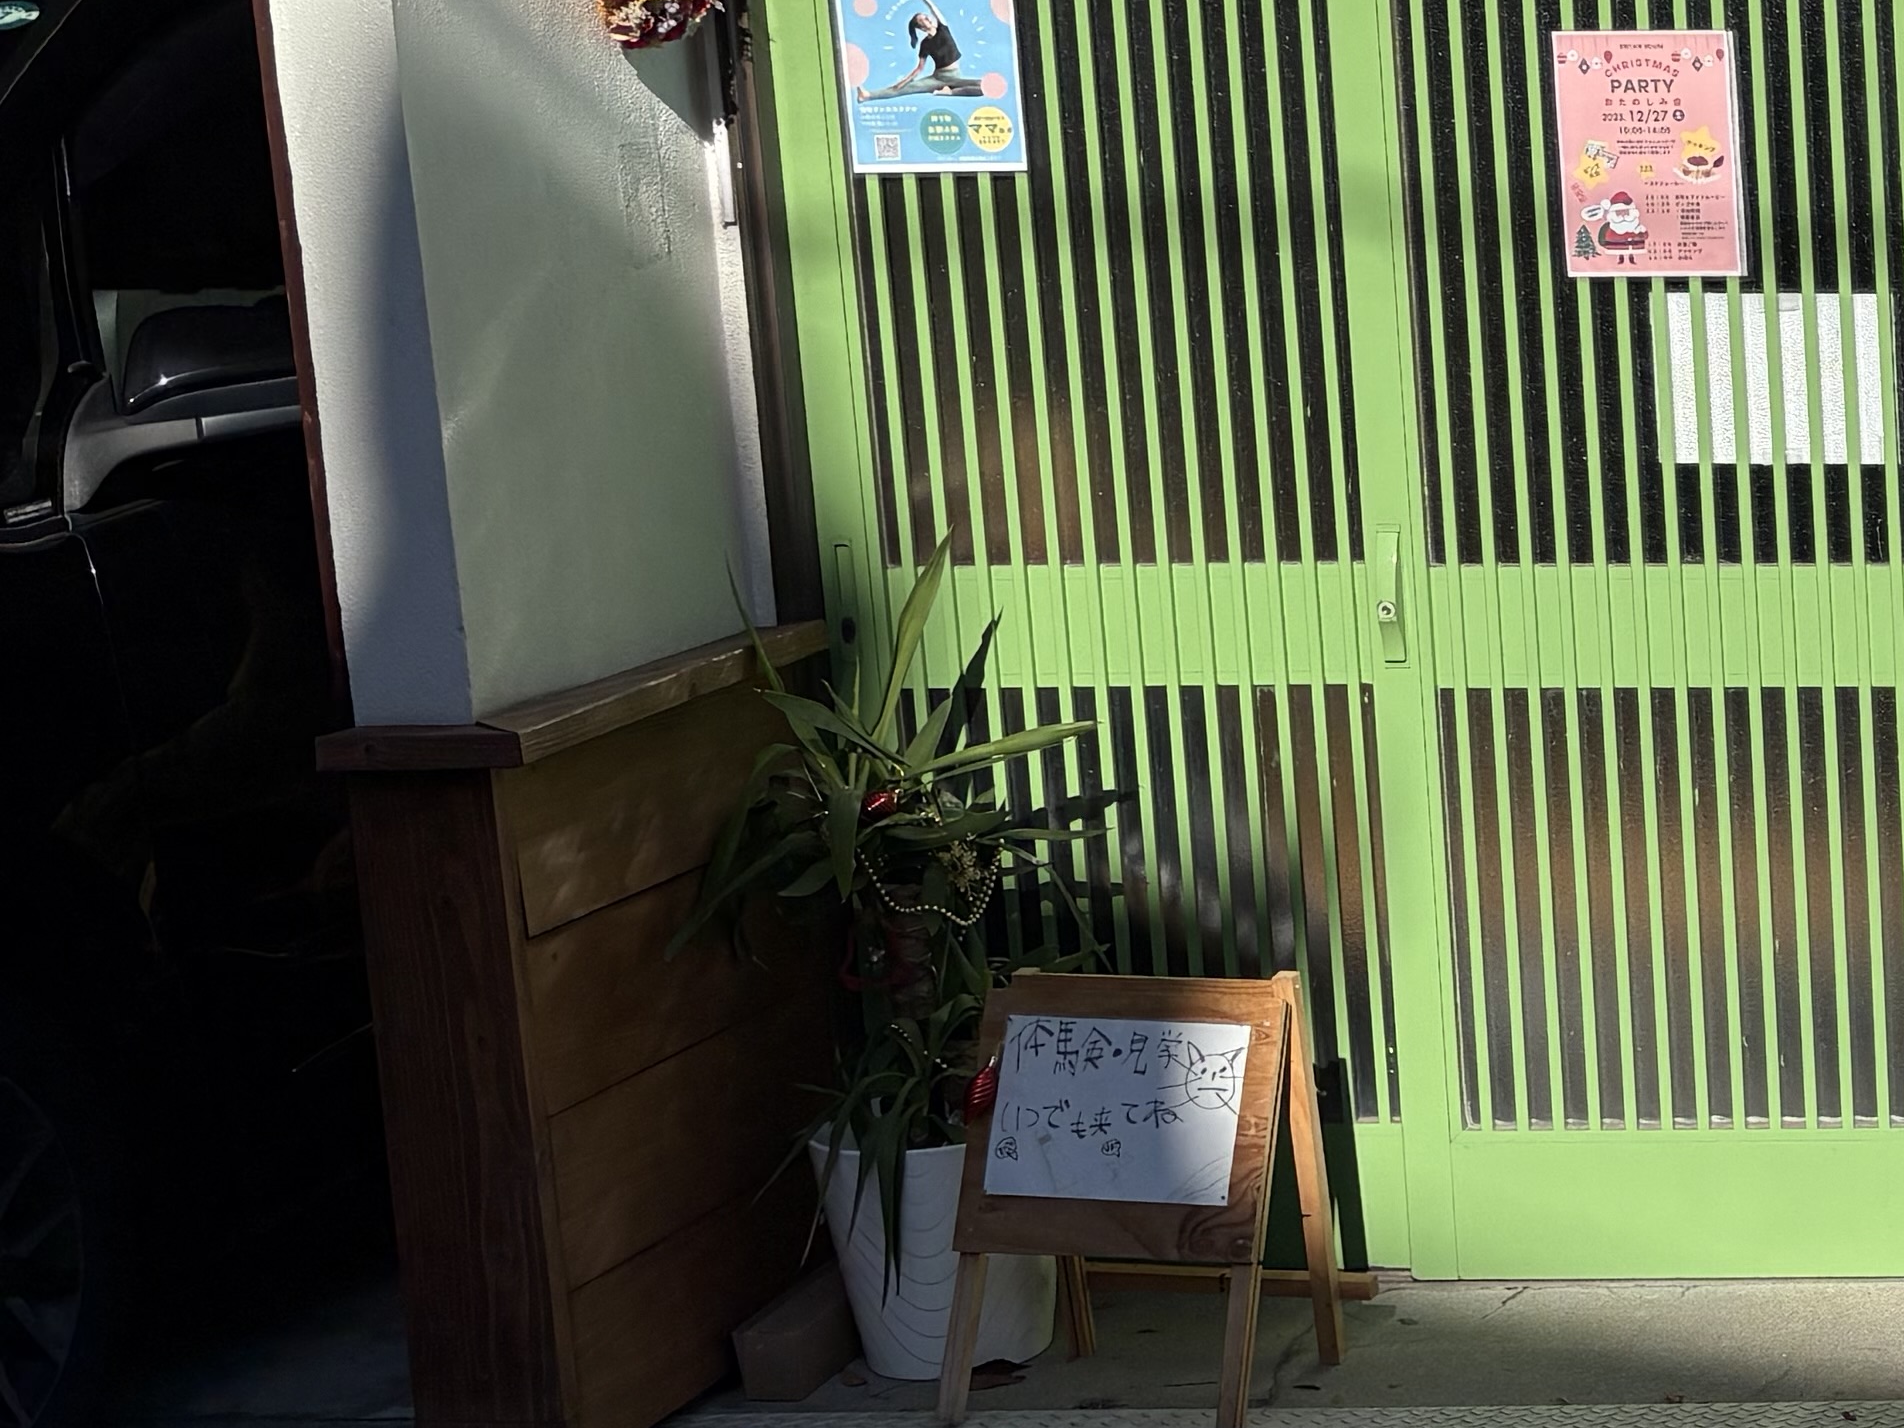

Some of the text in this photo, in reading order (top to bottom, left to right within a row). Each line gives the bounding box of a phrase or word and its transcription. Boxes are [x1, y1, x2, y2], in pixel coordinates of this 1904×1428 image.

[1604, 58, 1680, 78] CHRISTMAS
[1610, 79, 1675, 93] PARTY
[1629, 109, 1669, 124] 12/27
[1001, 1099, 1184, 1139] いつでも来てね
